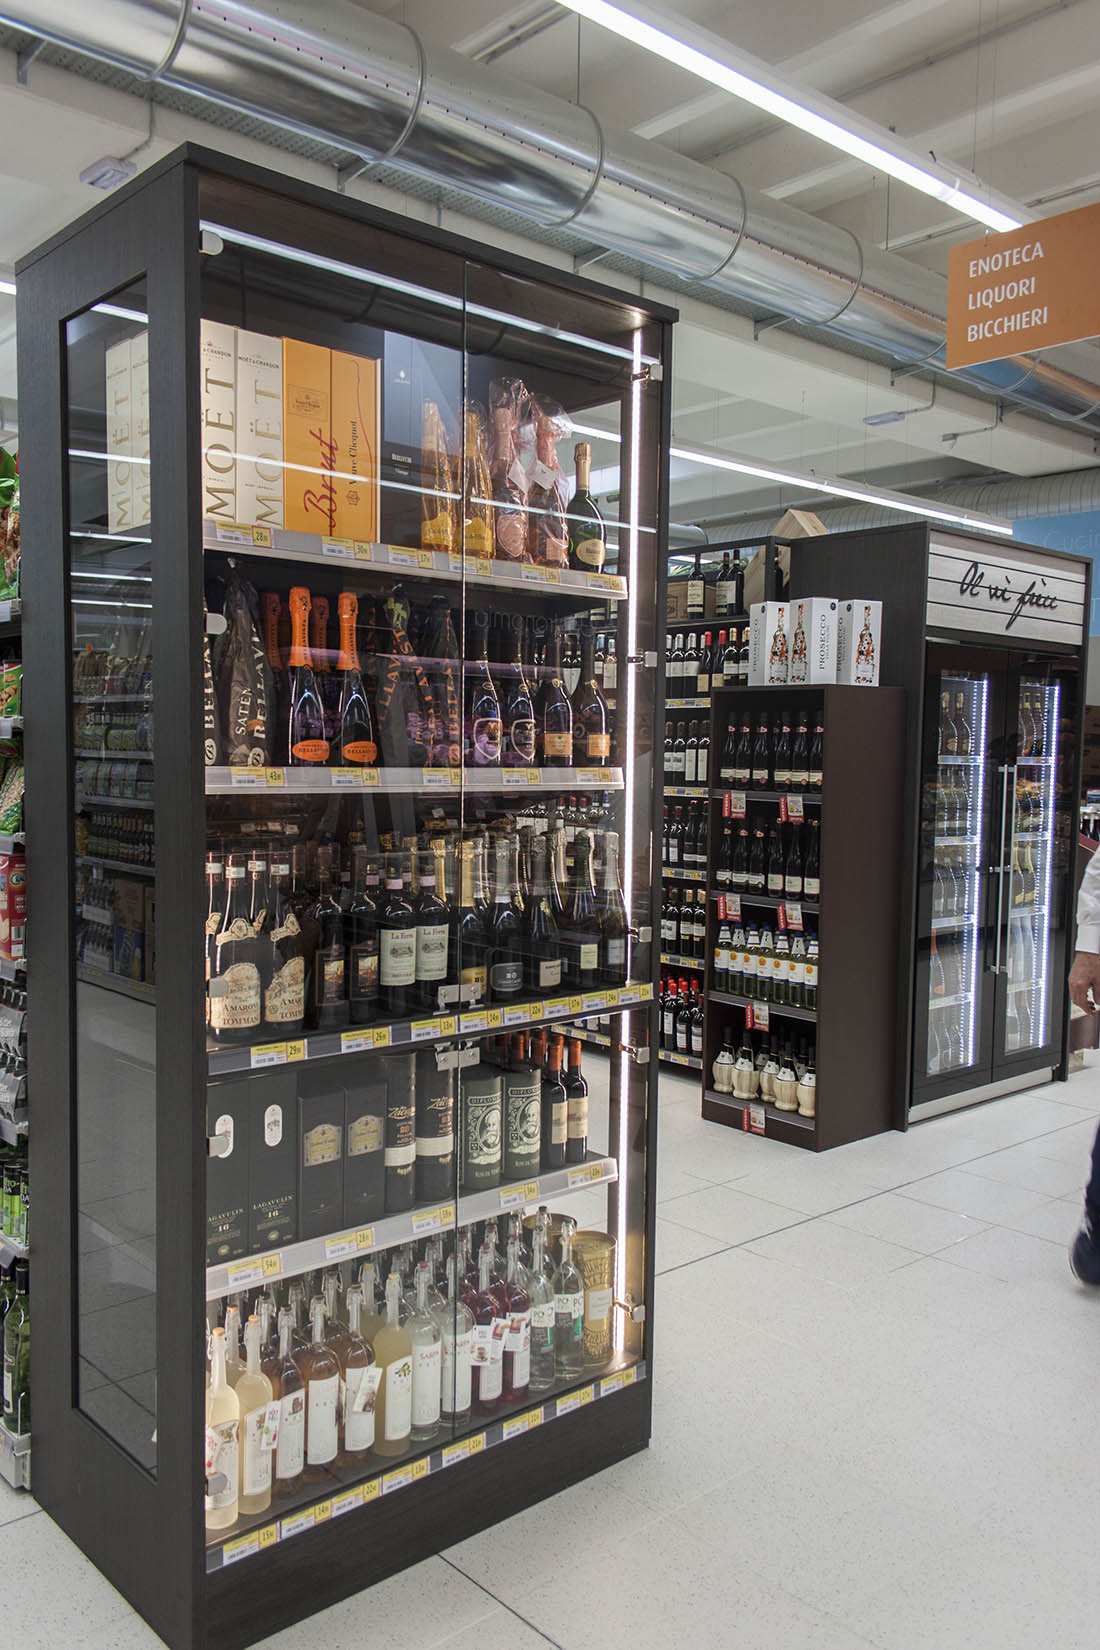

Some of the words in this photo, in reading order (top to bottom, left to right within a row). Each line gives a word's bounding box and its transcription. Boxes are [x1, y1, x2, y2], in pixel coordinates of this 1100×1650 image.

[968, 241, 1044, 278] ENOTECA
[967, 276, 1036, 310] LIQUORI
[967, 306, 1048, 342] BICCHIERI
[303, 427, 339, 529] Brut
[819, 614, 827, 669] PROSECCO
[218, 1224, 230, 1232] 16
[268, 1210, 279, 1218] 16
